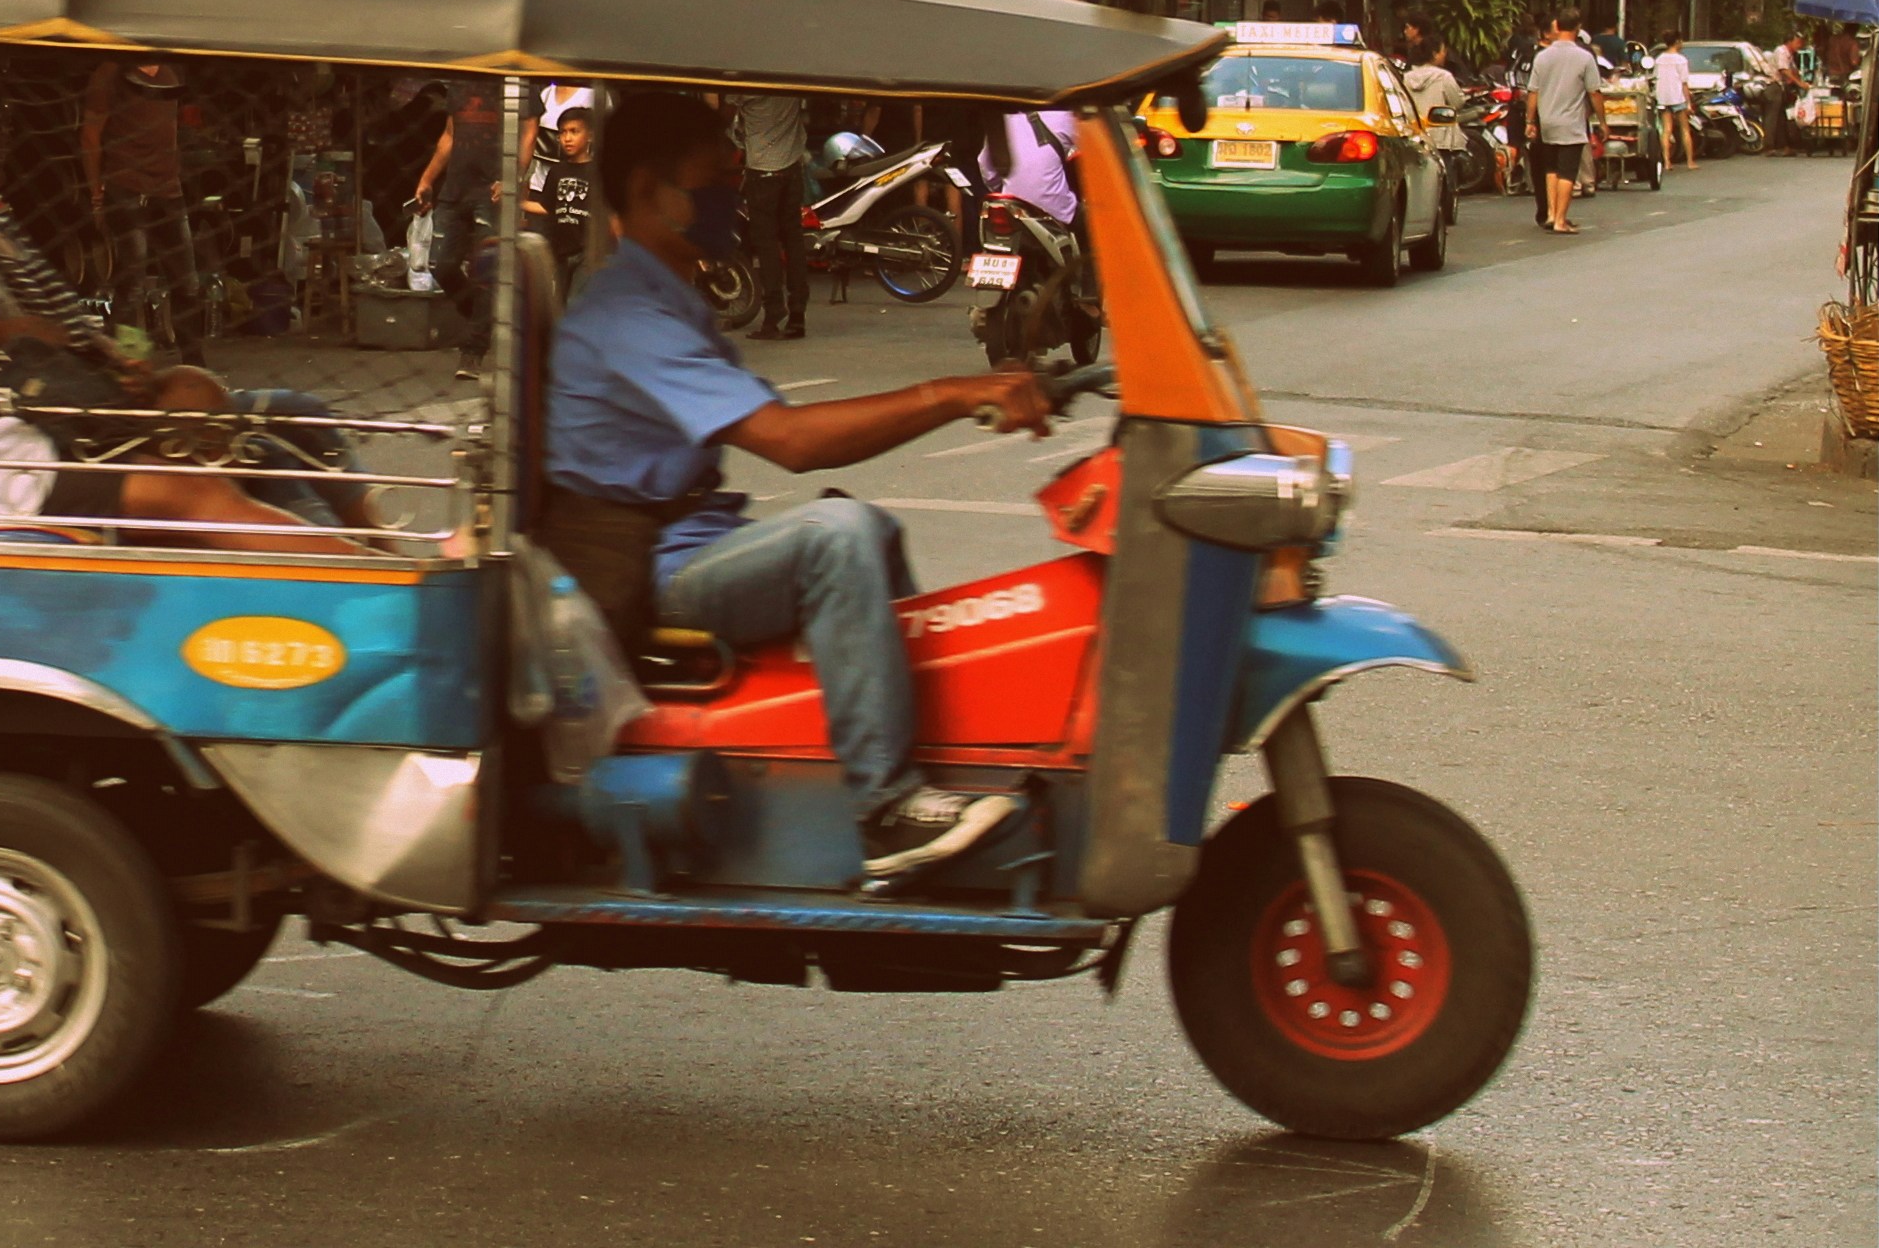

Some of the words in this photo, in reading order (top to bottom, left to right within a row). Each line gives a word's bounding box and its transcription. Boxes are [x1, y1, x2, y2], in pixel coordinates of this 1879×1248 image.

[1240, 23, 1276, 39] TAXI
[1282, 25, 1331, 40] METER
[896, 582, 1046, 639] 79068
